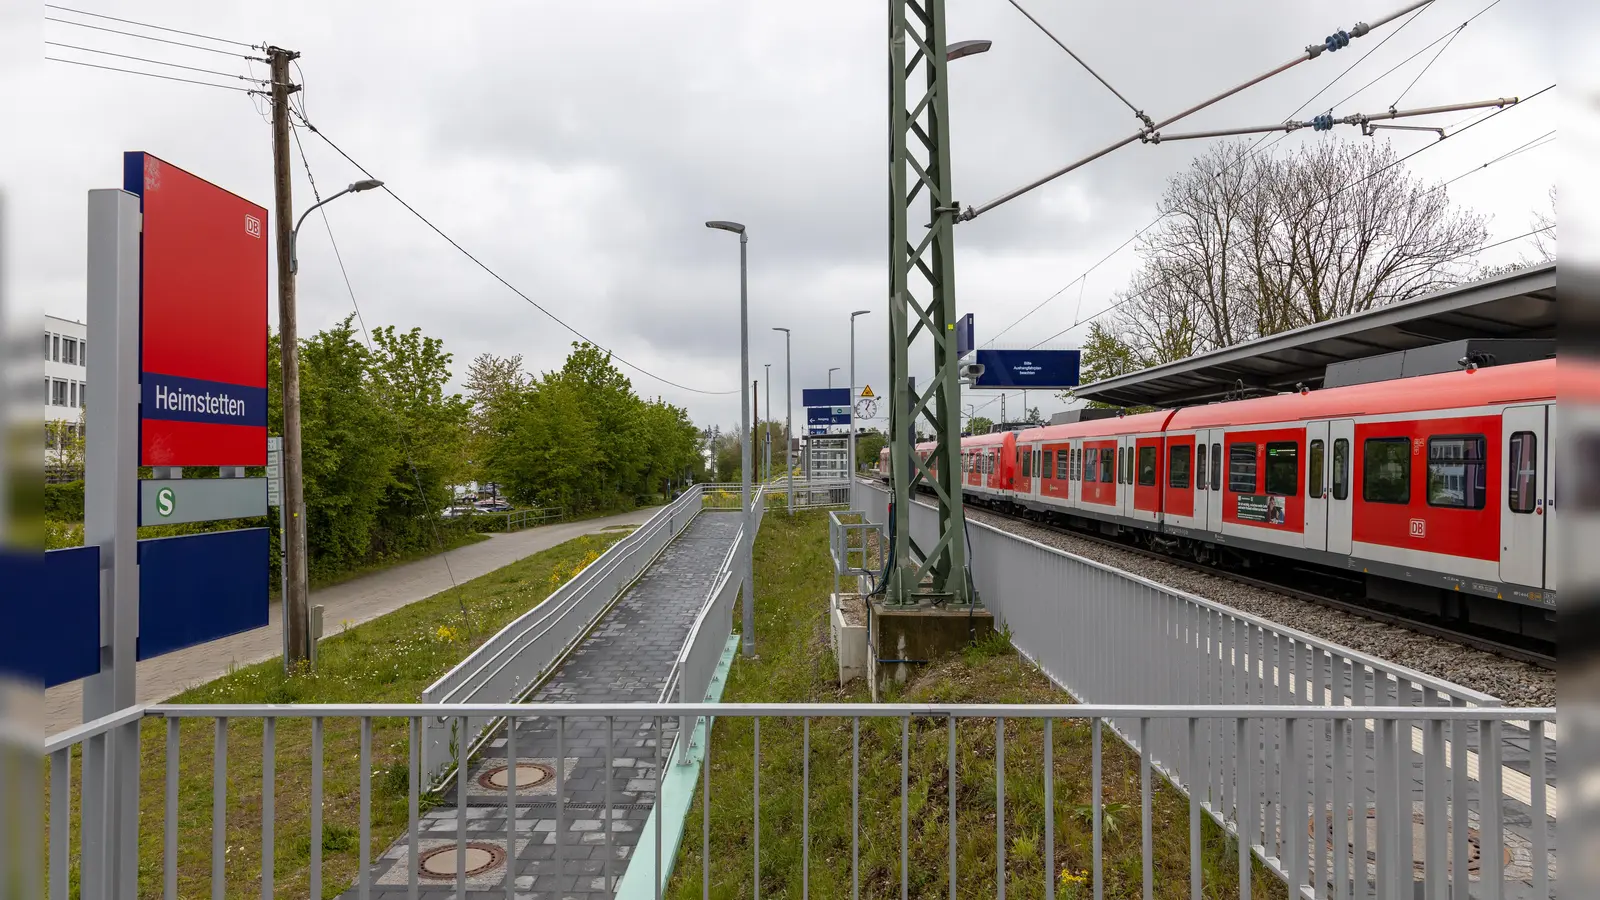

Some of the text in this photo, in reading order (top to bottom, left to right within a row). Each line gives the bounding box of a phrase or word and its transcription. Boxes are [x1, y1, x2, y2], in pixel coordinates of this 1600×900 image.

[247, 217, 259, 235] DB
[156, 385, 245, 416] Heimstetten
[159, 489, 173, 515] S
[1411, 520, 1424, 535] DB
